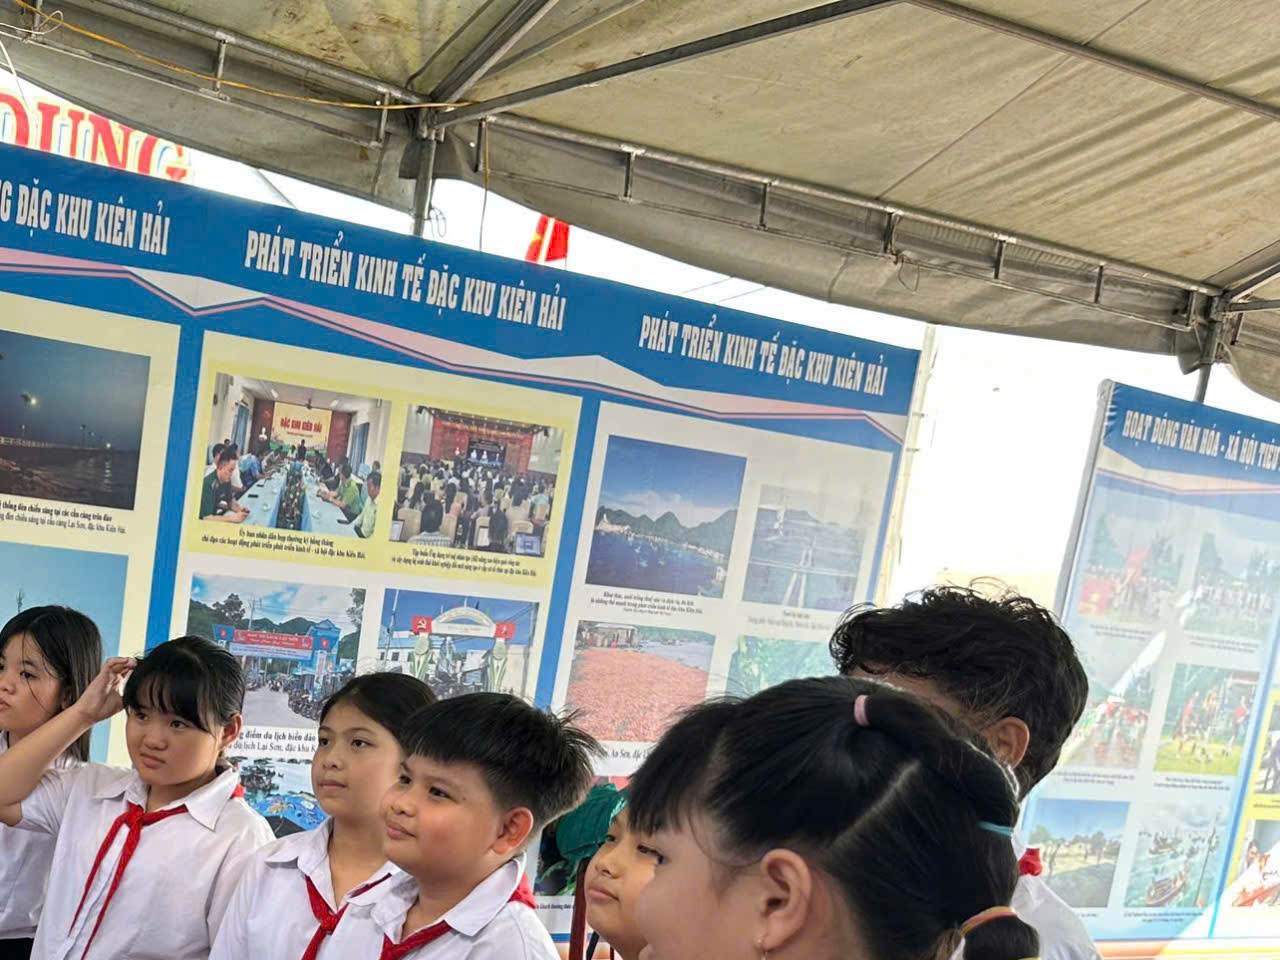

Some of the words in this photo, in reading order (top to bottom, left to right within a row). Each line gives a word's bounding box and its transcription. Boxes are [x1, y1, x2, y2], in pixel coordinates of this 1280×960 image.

[15, 178, 52, 238] ĐẶC
[55, 192, 93, 242] KHU
[95, 195, 138, 251] KIÊN
[139, 200, 171, 256] HẢI
[244, 224, 295, 276] PHÁT
[299, 230, 353, 288] TRIỂN
[354, 253, 399, 297] KINH
[401, 252, 427, 303] TẾ
[426, 263, 460, 316] ĐẶC
[461, 276, 497, 318] KHU
[496, 278, 537, 325] KIÊN
[536, 281, 568, 331] HẢI
[638, 309, 680, 355] PHÁT
[680, 313, 724, 364] TRIỂN
[723, 332, 759, 370] KINH
[758, 330, 781, 374] TẾ
[777, 339, 805, 386] ĐẶC
[804, 351, 835, 386] KHU
[832, 351, 866, 392] KIÊN
[863, 353, 889, 397] HẢI
